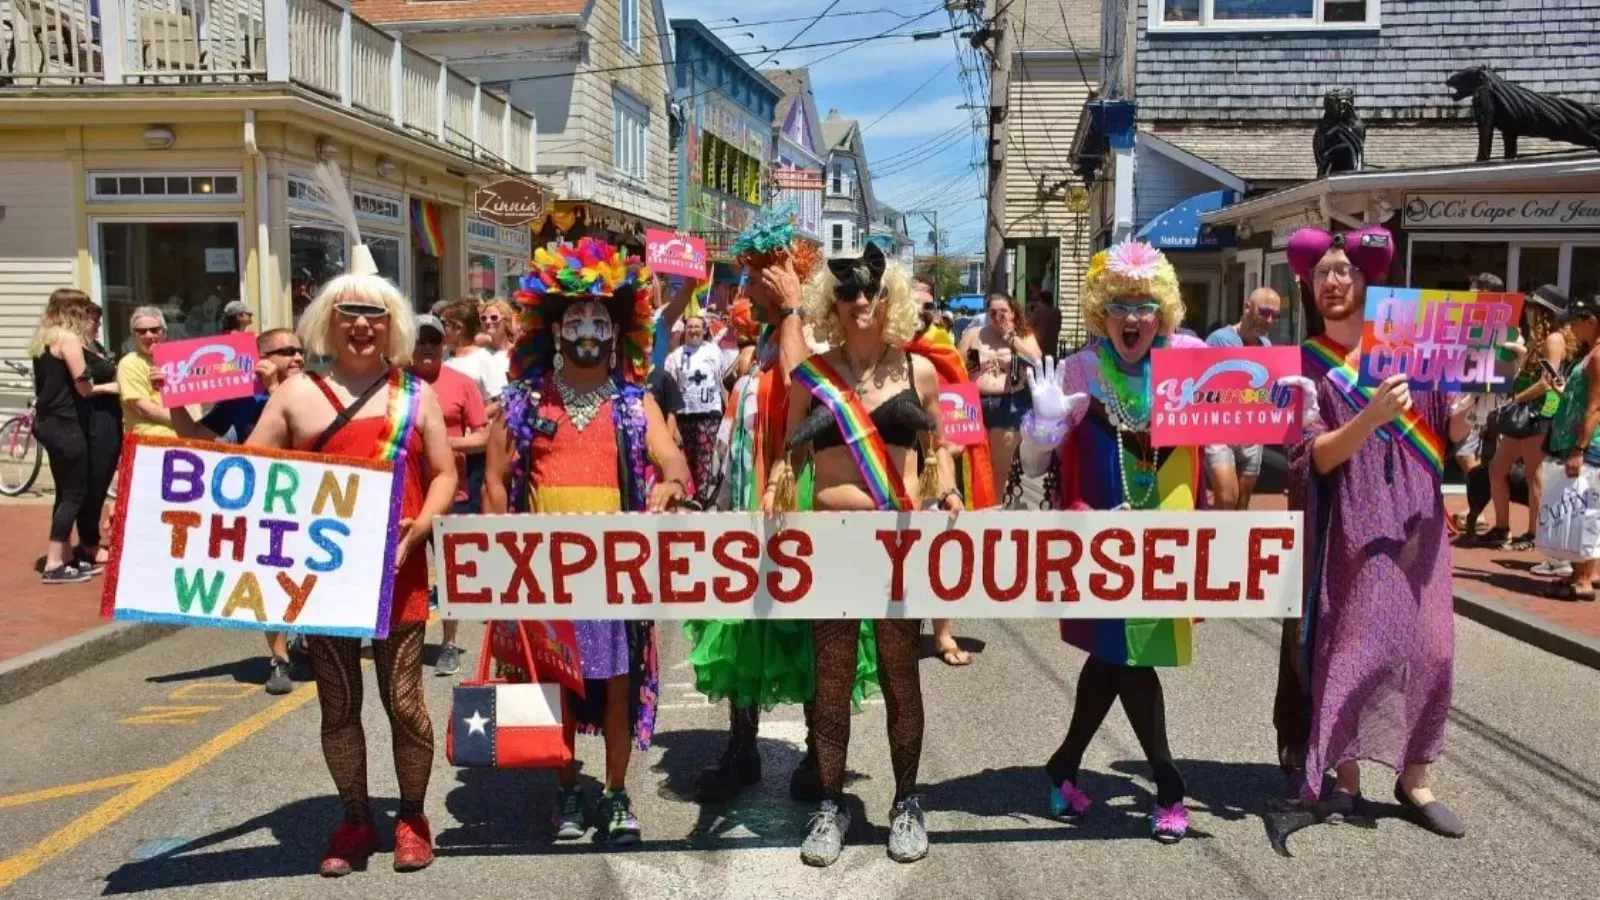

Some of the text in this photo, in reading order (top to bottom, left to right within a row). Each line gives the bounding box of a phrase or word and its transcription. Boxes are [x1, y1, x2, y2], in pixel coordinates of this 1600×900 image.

[479, 189, 540, 216] Zinnia
[1471, 200, 1516, 223] Cape
[1521, 199, 1559, 218] Cod
[1161, 236, 1198, 245] Nature's
[1374, 297, 1513, 346] QUEER
[1156, 359, 1292, 412] Yourself
[1369, 343, 1505, 383] COUNCIL
[1156, 410, 1296, 427] PROVINCETOWN
[161, 449, 360, 519] BORN
[161, 510, 351, 572] THIS
[443, 528, 1295, 603] EXPRESS YOURSELF
[174, 567, 317, 623] WAY
